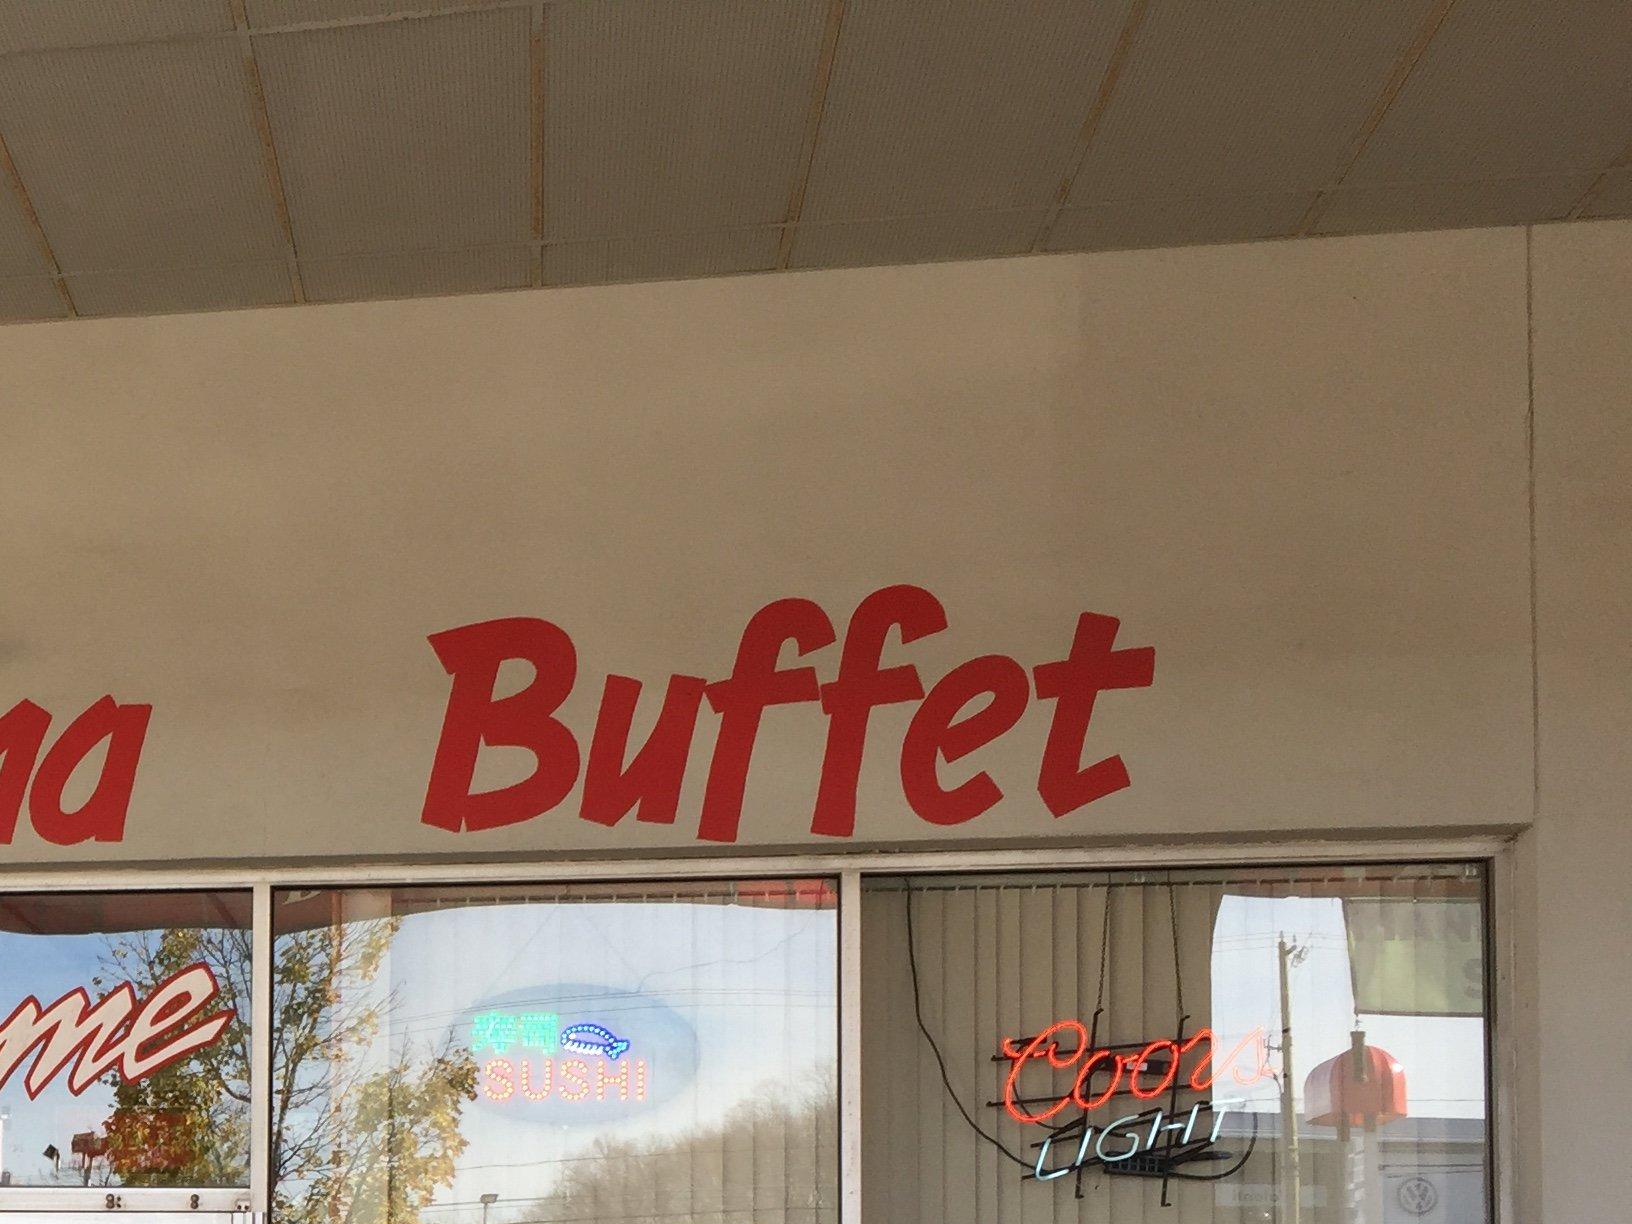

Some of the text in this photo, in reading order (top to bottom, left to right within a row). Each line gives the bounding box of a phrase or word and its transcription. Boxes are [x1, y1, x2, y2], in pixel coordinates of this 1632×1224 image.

[420, 584, 1155, 843] Buffet
[483, 1057, 647, 1102] SUSHI
[1002, 1019, 1274, 1123] Coors
[1035, 1099, 1246, 1180] LIGHT
